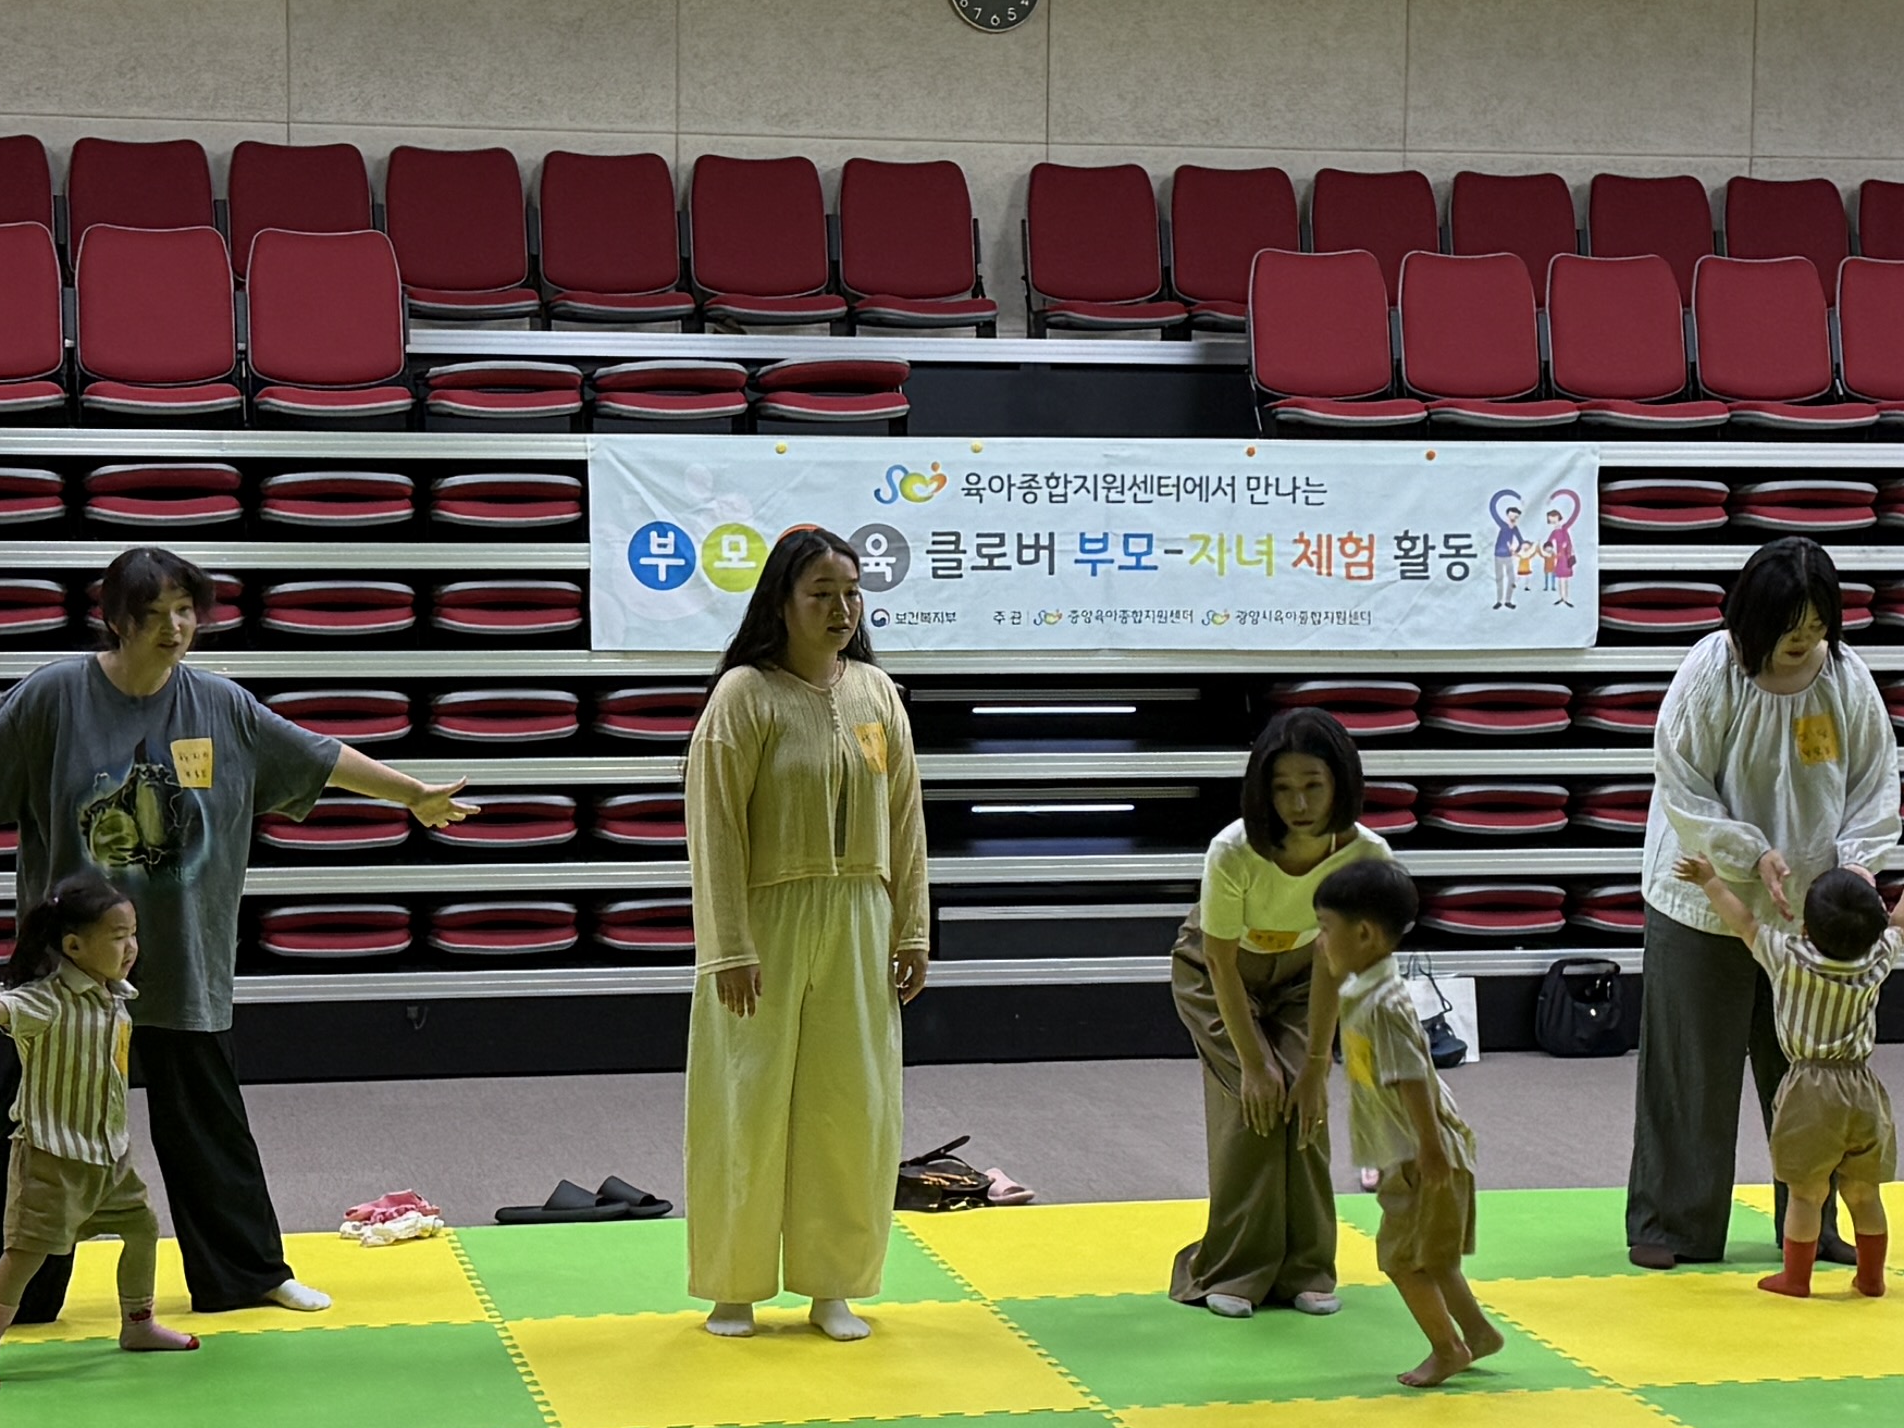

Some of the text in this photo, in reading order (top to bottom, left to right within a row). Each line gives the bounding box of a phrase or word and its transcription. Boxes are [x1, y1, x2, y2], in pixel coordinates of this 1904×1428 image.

[974, 7, 982, 20] 7
[990, 14, 1001, 26] 6
[1007, 7, 1017, 21] 5
[961, 471, 1328, 506] 육아종합지원센터에서 만나는
[925, 530, 1056, 580] 클로버
[1074, 531, 1275, 578] 부모-자녀
[1291, 529, 1376, 582] 체험
[1393, 528, 1479, 582] 활동
[895, 610, 957, 625] 보건복지부
[1067, 609, 1193, 625] 중앙육아종합지원센터
